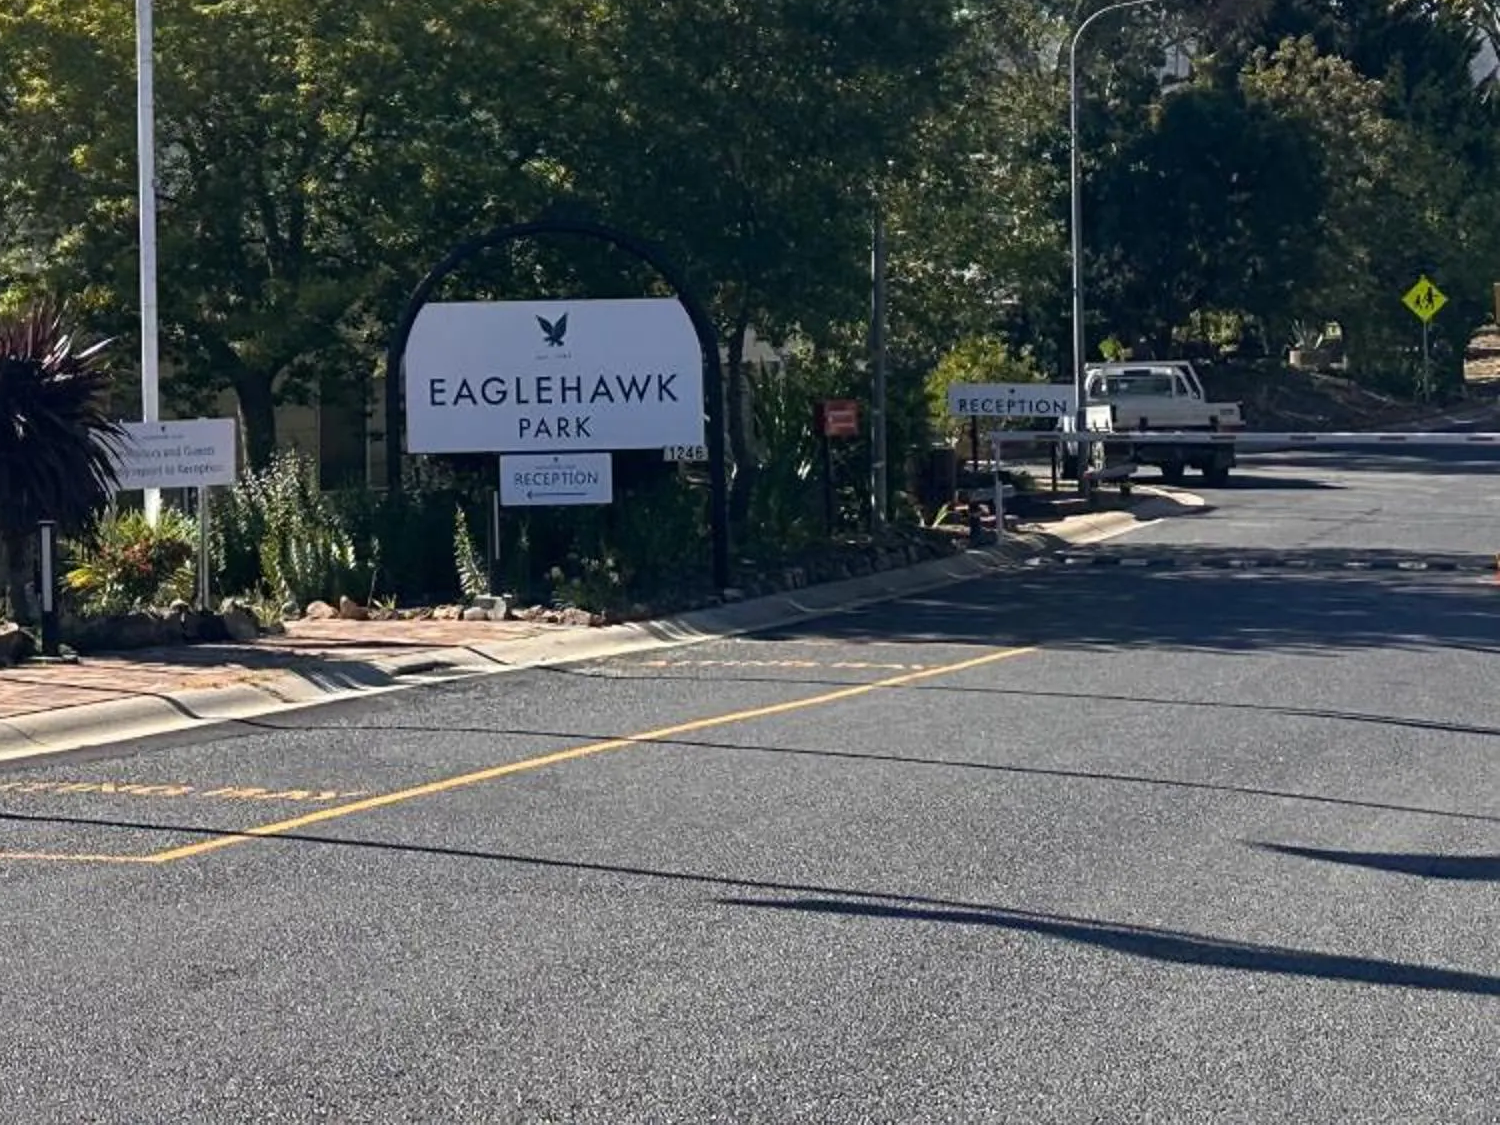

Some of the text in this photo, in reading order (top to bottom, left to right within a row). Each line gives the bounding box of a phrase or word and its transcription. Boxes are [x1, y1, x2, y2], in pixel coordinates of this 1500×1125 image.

[429, 373, 678, 406] EAGLEHAWK
[958, 398, 1068, 414] RECEPTION
[518, 416, 592, 439] PARK
[514, 472, 599, 487] RECEPTION
